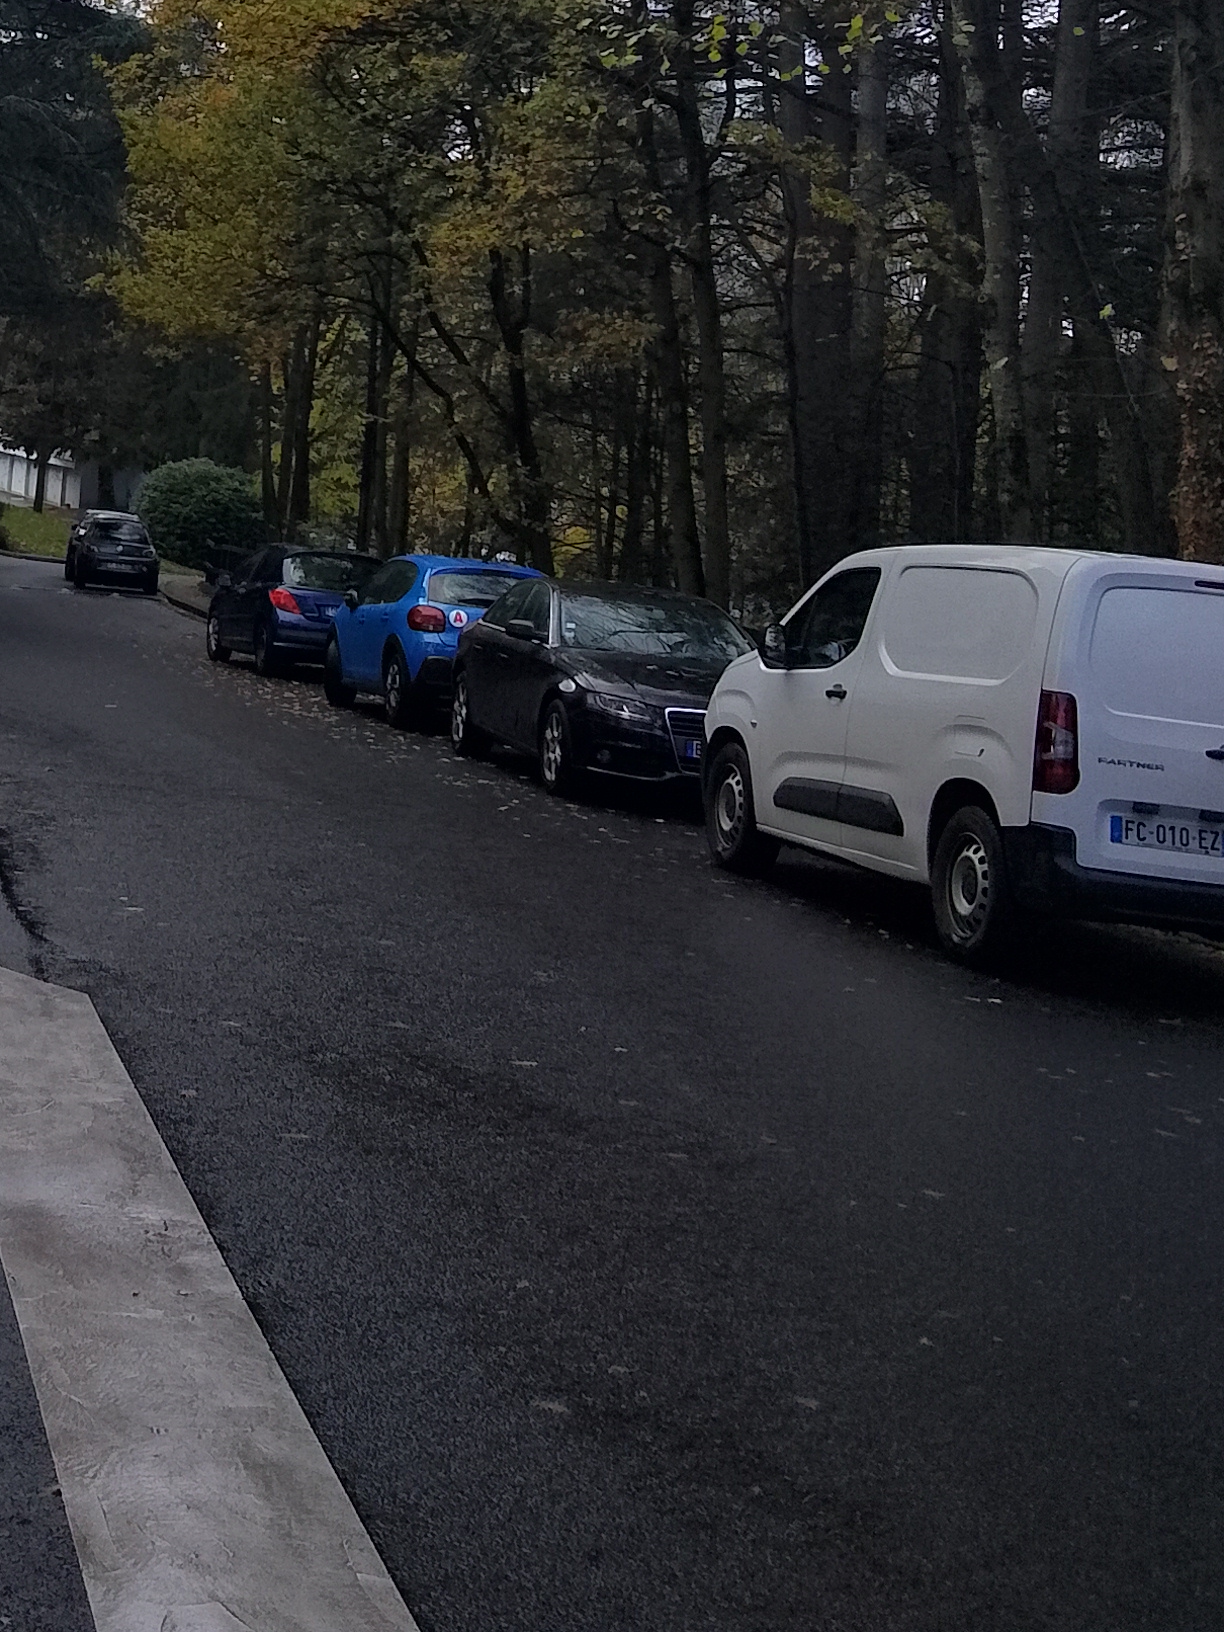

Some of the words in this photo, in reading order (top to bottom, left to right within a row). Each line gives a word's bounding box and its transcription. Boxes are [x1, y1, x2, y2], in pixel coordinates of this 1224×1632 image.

[453, 611, 463, 623] A
[1097, 757, 1165, 771] PARTNER
[1124, 819, 1221, 851] FC-010-EZ
